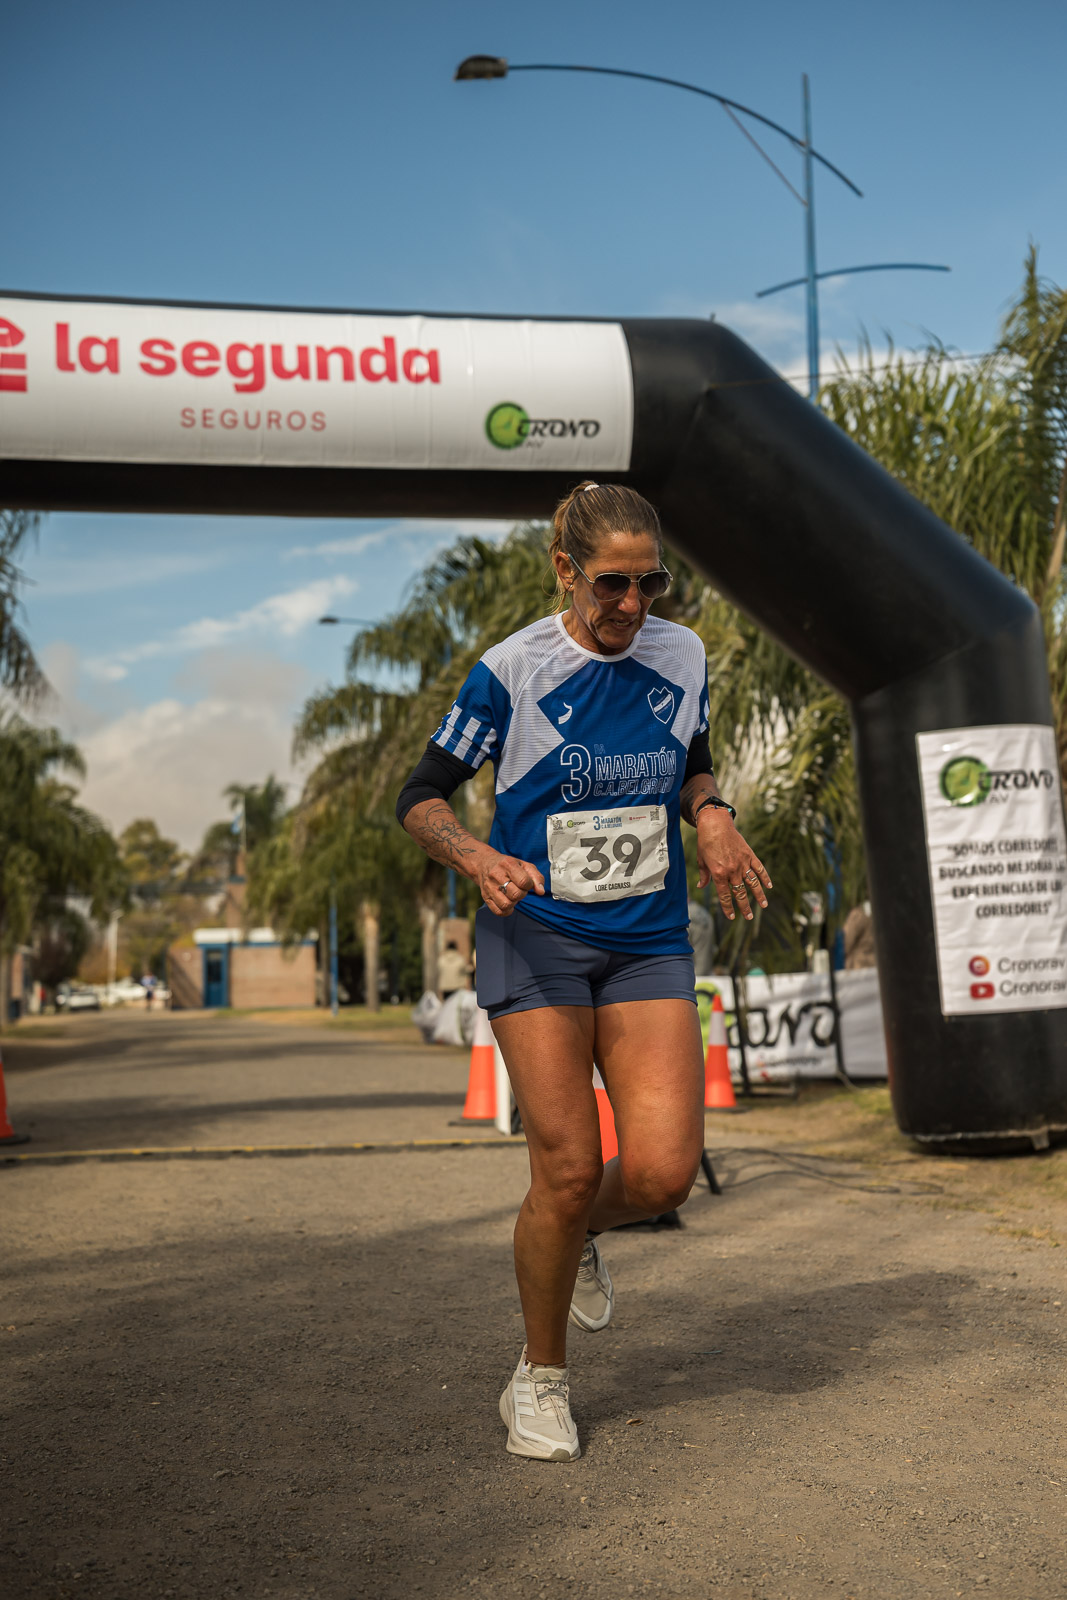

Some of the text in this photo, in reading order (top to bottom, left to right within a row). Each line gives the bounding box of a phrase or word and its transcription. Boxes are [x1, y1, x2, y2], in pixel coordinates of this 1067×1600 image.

[55, 322, 441, 394] la segunda
[180, 407, 327, 432] SEGUROS
[517, 418, 602, 438] CRONO
[560, 743, 592, 804] 3
[594, 746, 677, 781] MARATÓN
[592, 815, 601, 831] 3
[579, 833, 642, 881] 39
[938, 861, 1005, 880] BUSCANDO
[594, 884, 608, 892] LORE
[997, 956, 1066, 974] Cronorav
